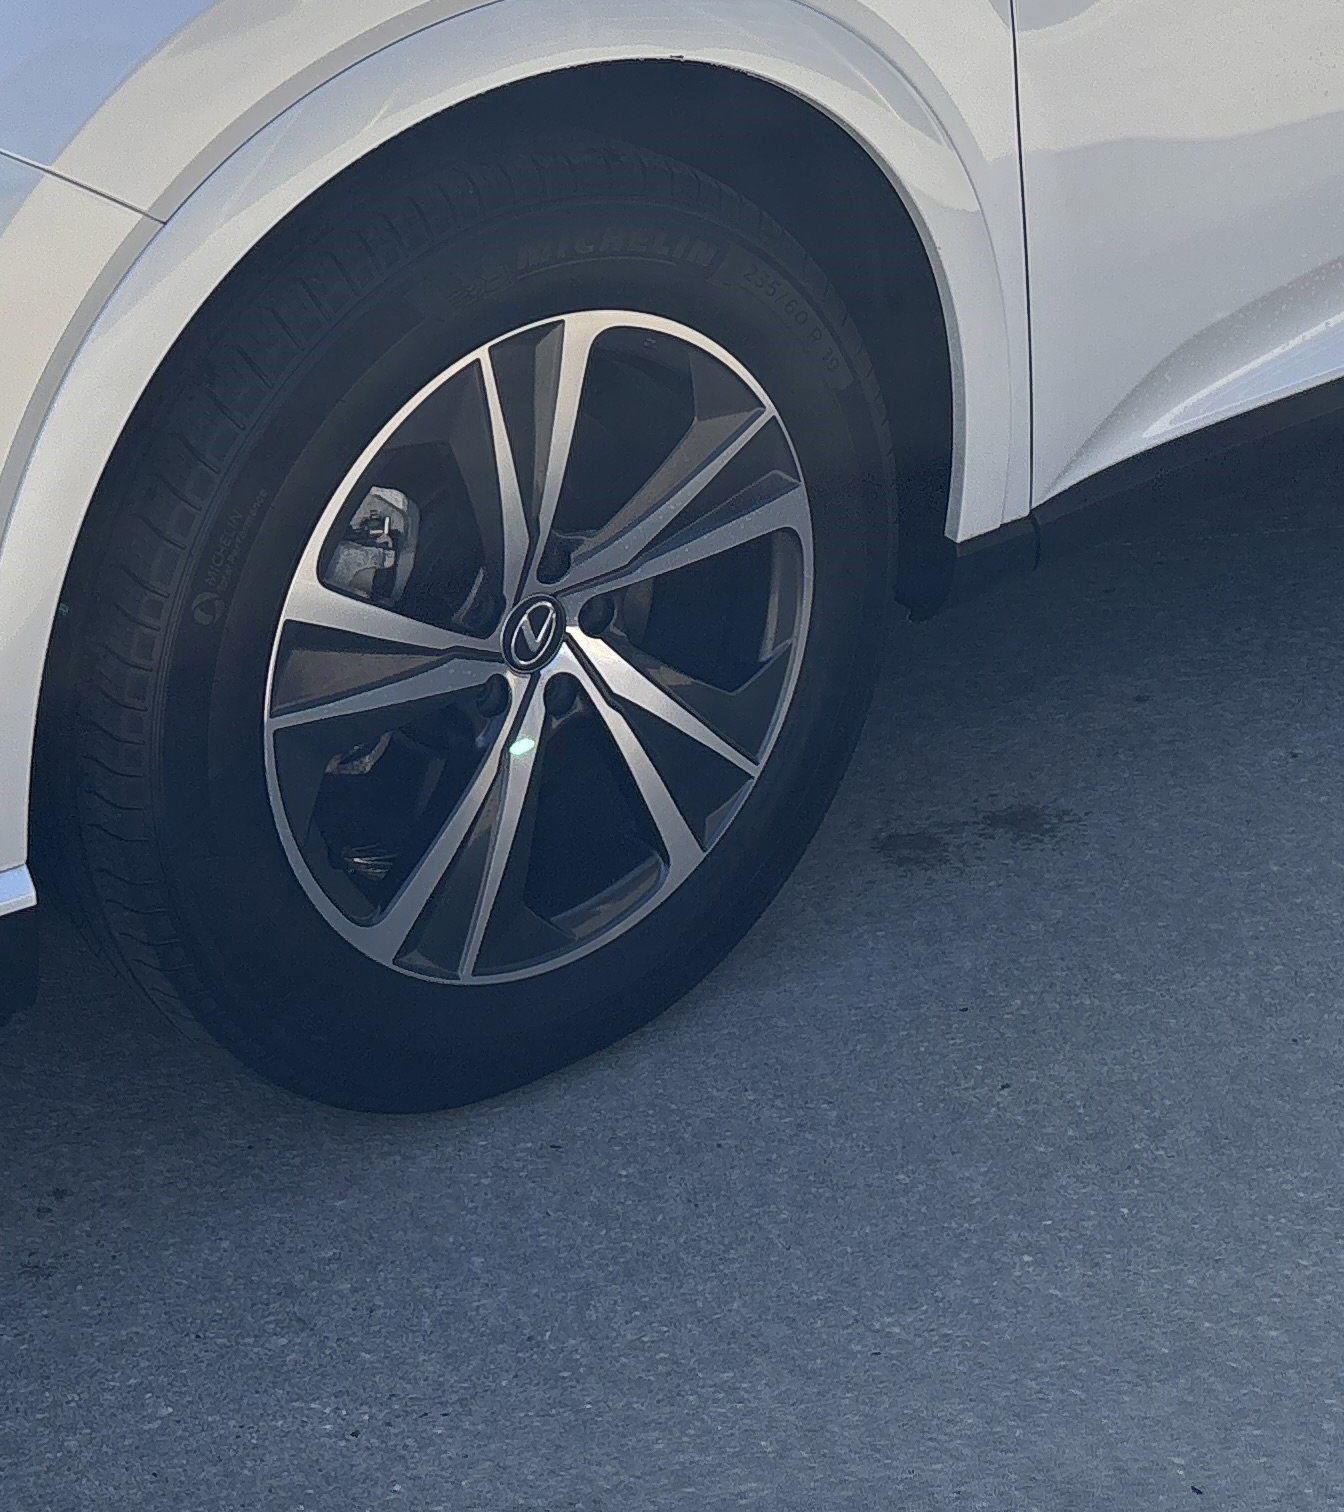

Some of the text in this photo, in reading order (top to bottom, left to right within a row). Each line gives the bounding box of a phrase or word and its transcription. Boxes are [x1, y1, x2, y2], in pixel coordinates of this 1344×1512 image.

[516, 228, 719, 267] MICHELIN
[743, 264, 809, 326] 235/60
[808, 326, 823, 344] R
[205, 509, 243, 586] MICHELIN
